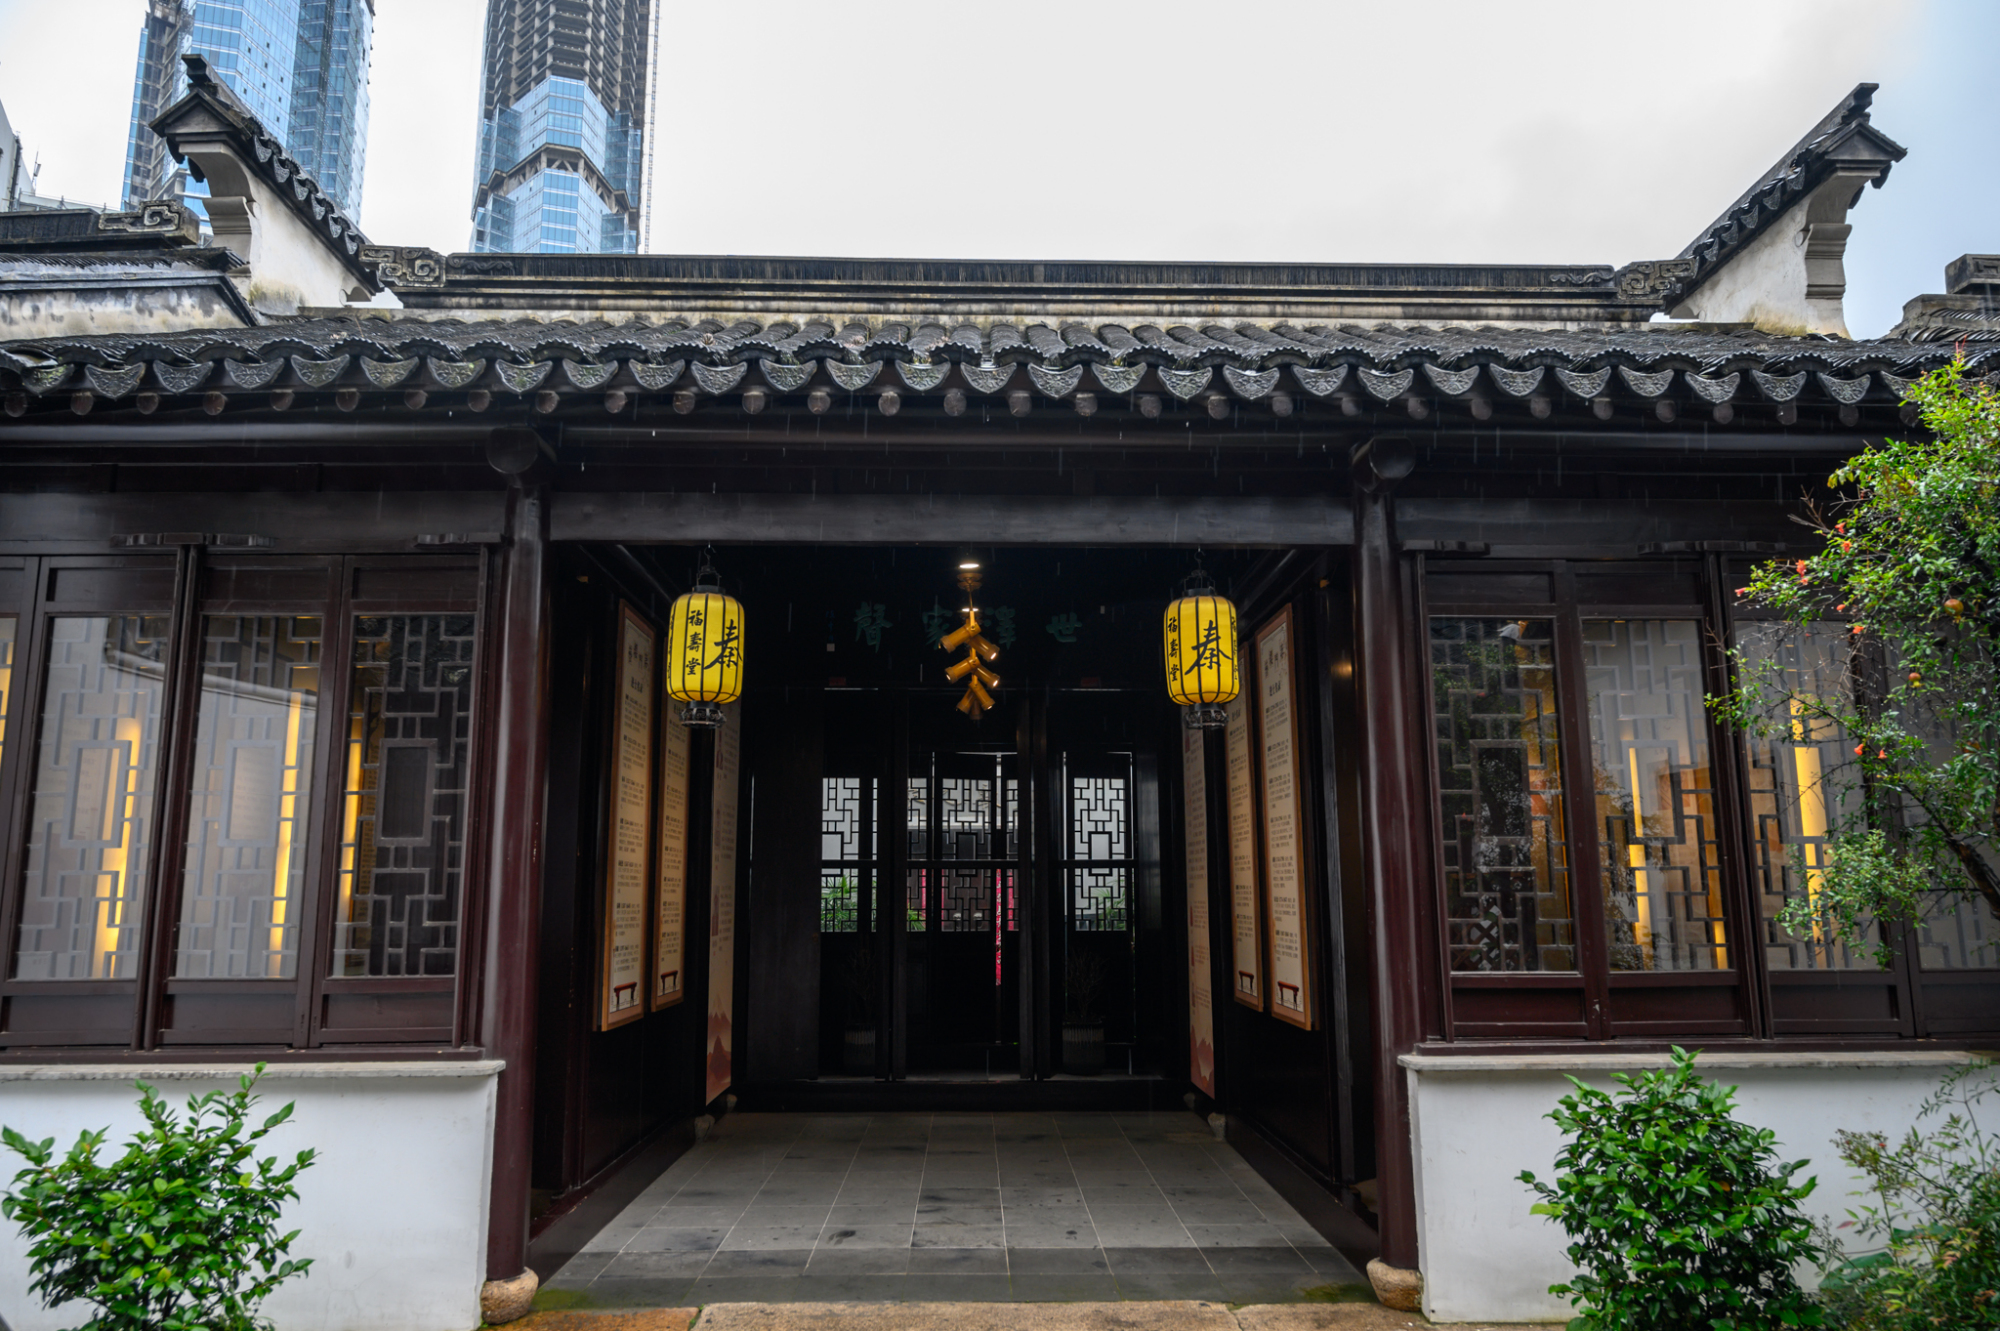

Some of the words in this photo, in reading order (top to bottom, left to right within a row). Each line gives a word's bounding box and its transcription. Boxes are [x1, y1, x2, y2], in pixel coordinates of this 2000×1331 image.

[687, 610, 703, 676] 福壽堂
[1168, 617, 1180, 682] 福壽堂
